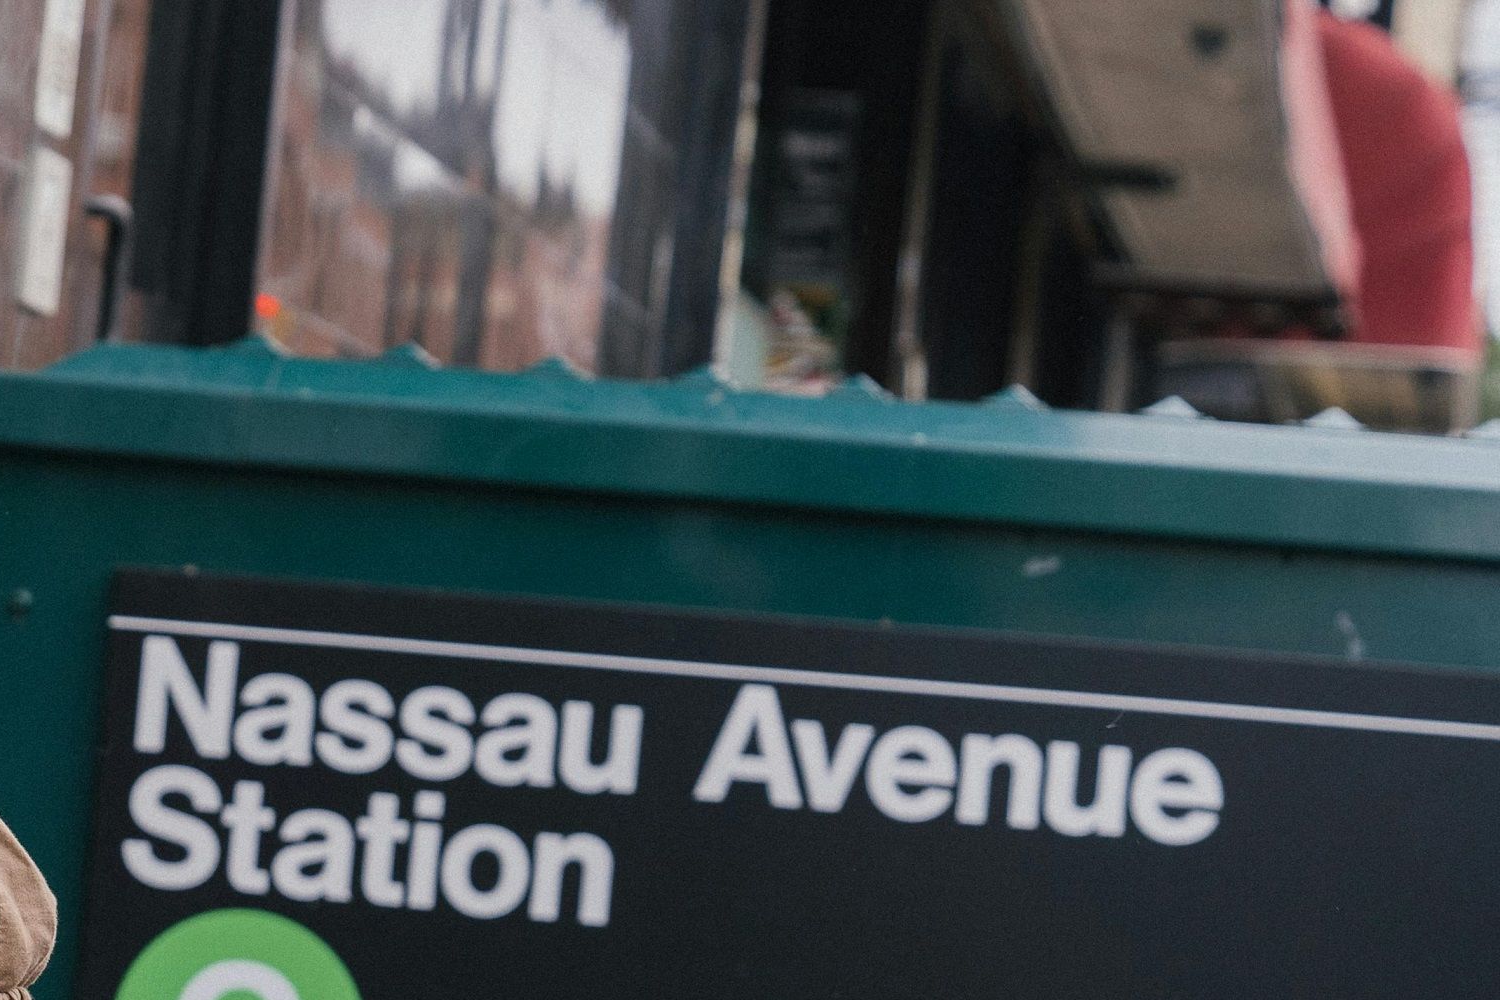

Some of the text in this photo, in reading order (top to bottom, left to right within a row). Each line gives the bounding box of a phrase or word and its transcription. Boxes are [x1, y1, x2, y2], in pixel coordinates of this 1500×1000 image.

[134, 634, 1224, 846] Nassau Avenue
[121, 764, 613, 926] Station
